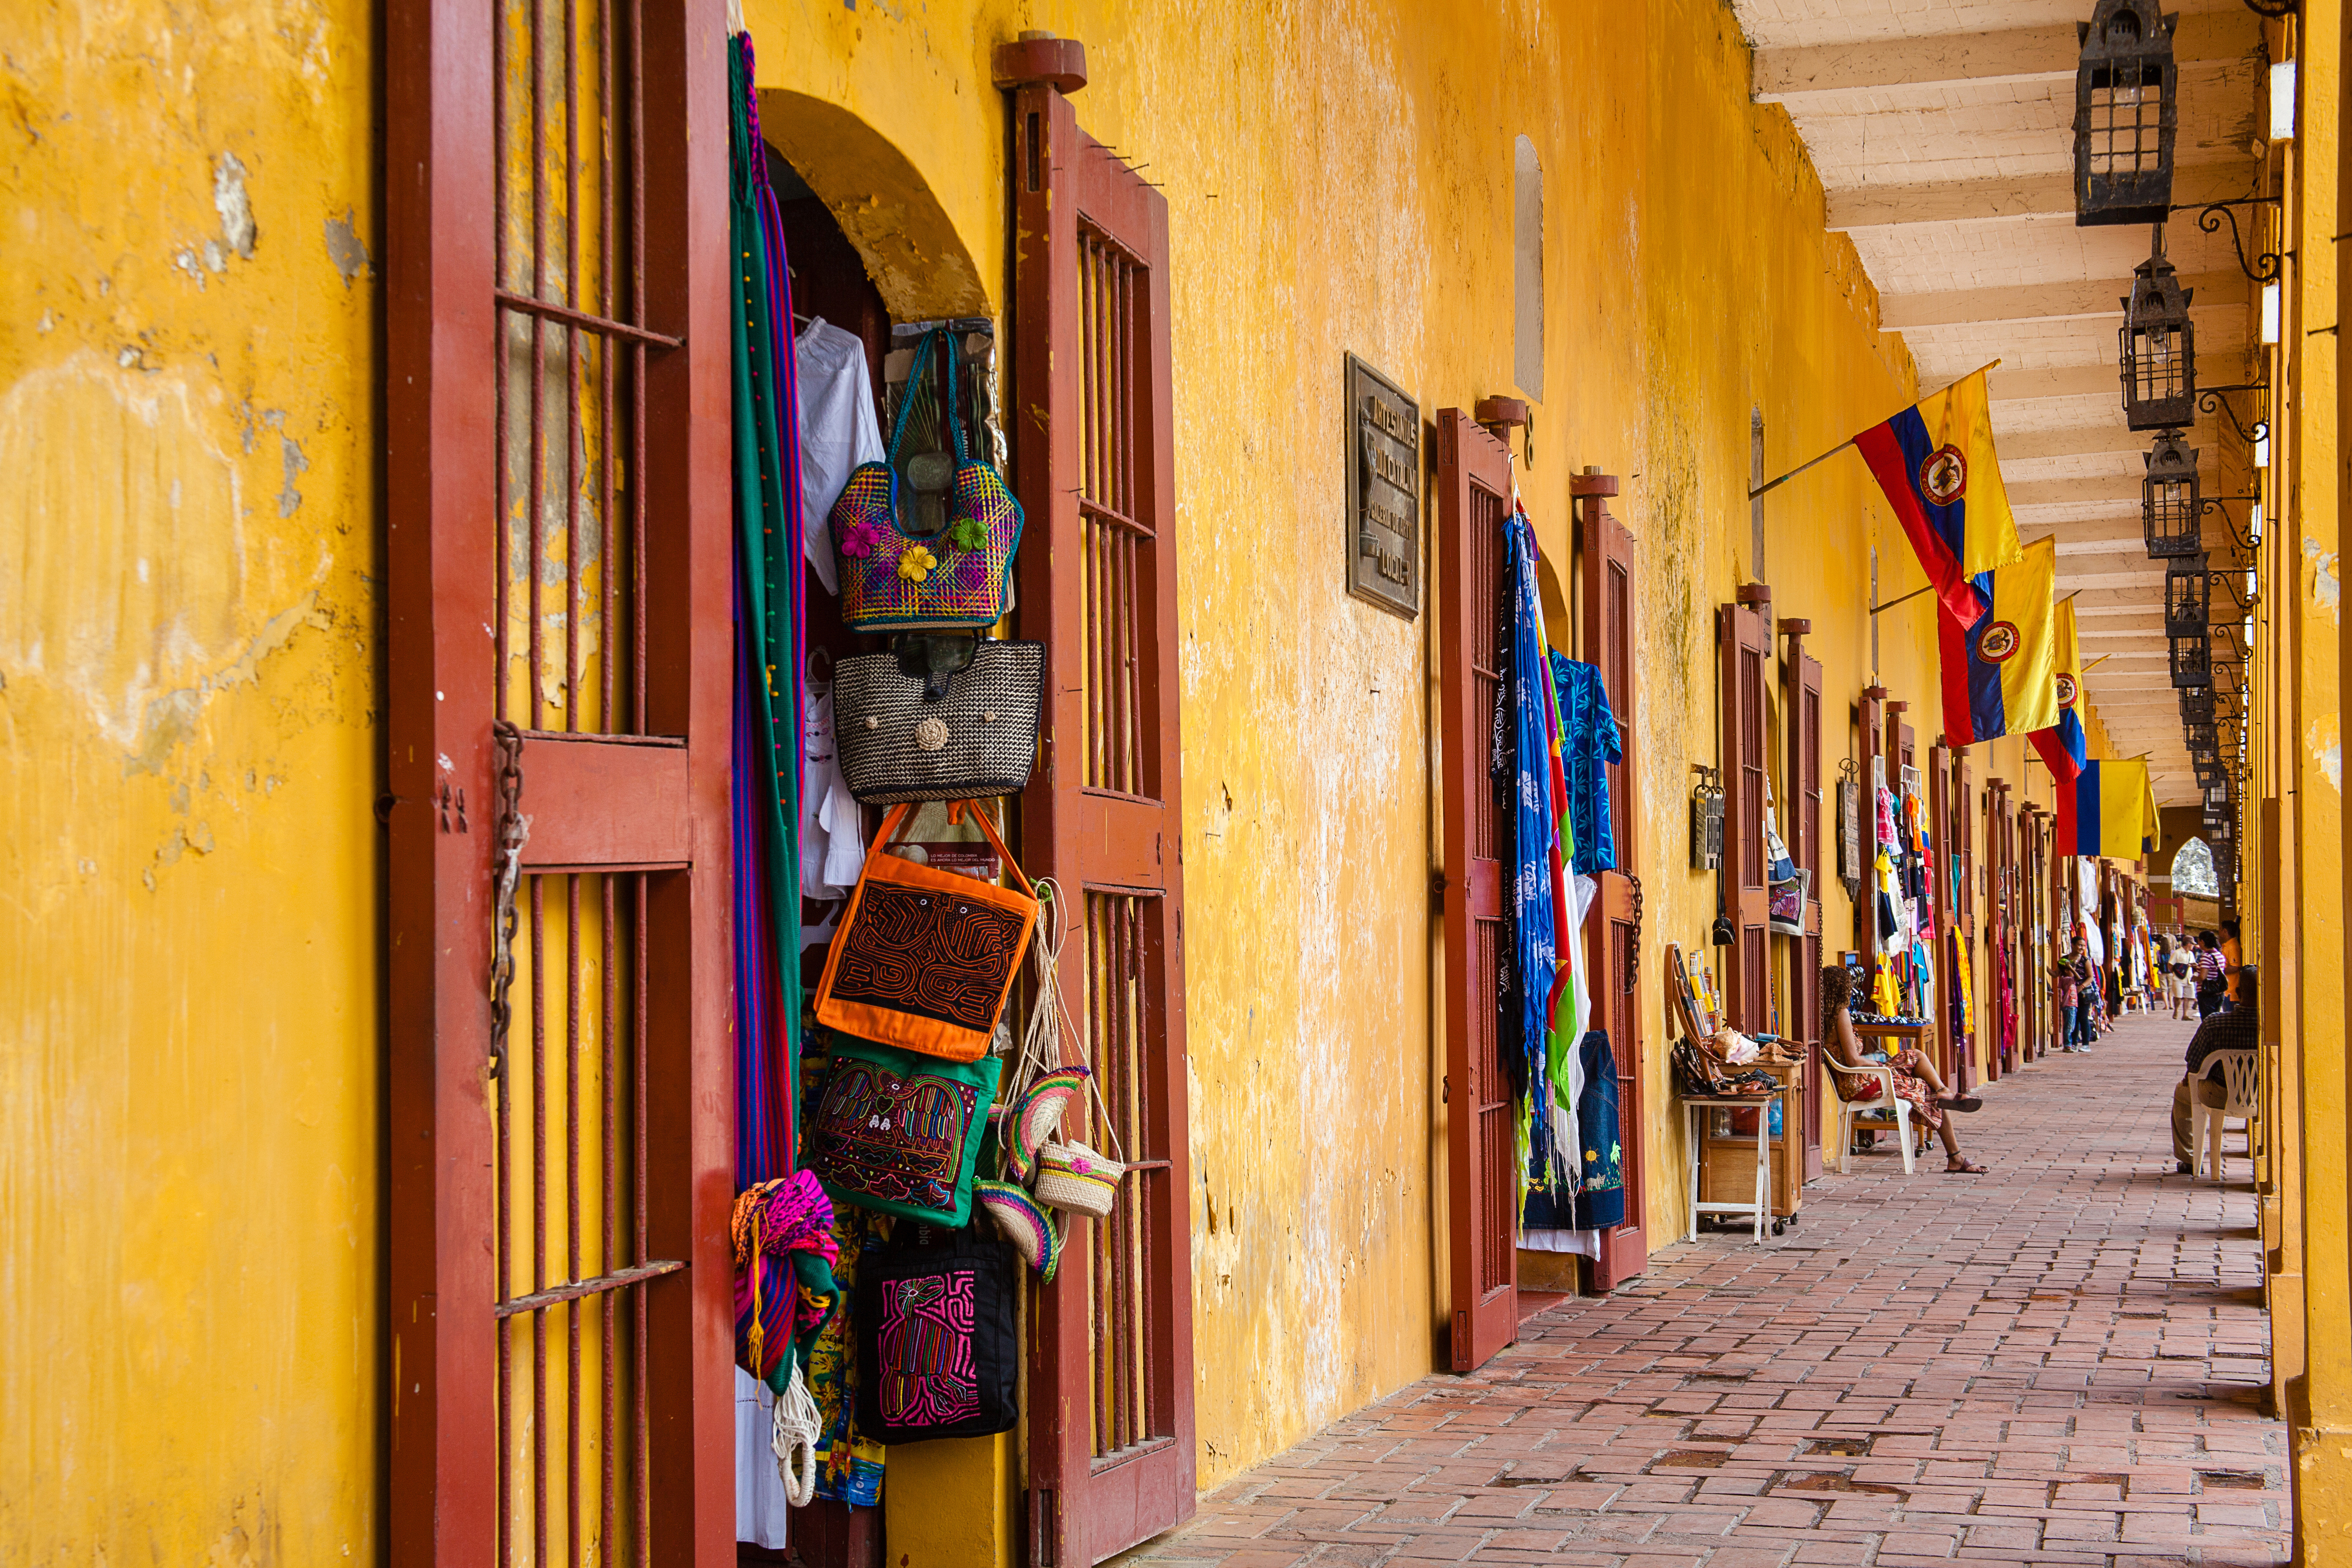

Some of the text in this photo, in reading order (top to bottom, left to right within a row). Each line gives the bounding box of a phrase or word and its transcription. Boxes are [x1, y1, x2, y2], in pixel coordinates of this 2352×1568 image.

[1374, 396, 1416, 449] ARTESANIAS
[1375, 446, 1417, 498] DIA CATALIN
[1945, 447, 1967, 480] EPUBLICA
[1372, 500, 1412, 540] GALERIA DE ARTE
[1382, 548, 1404, 583] LOCAL
